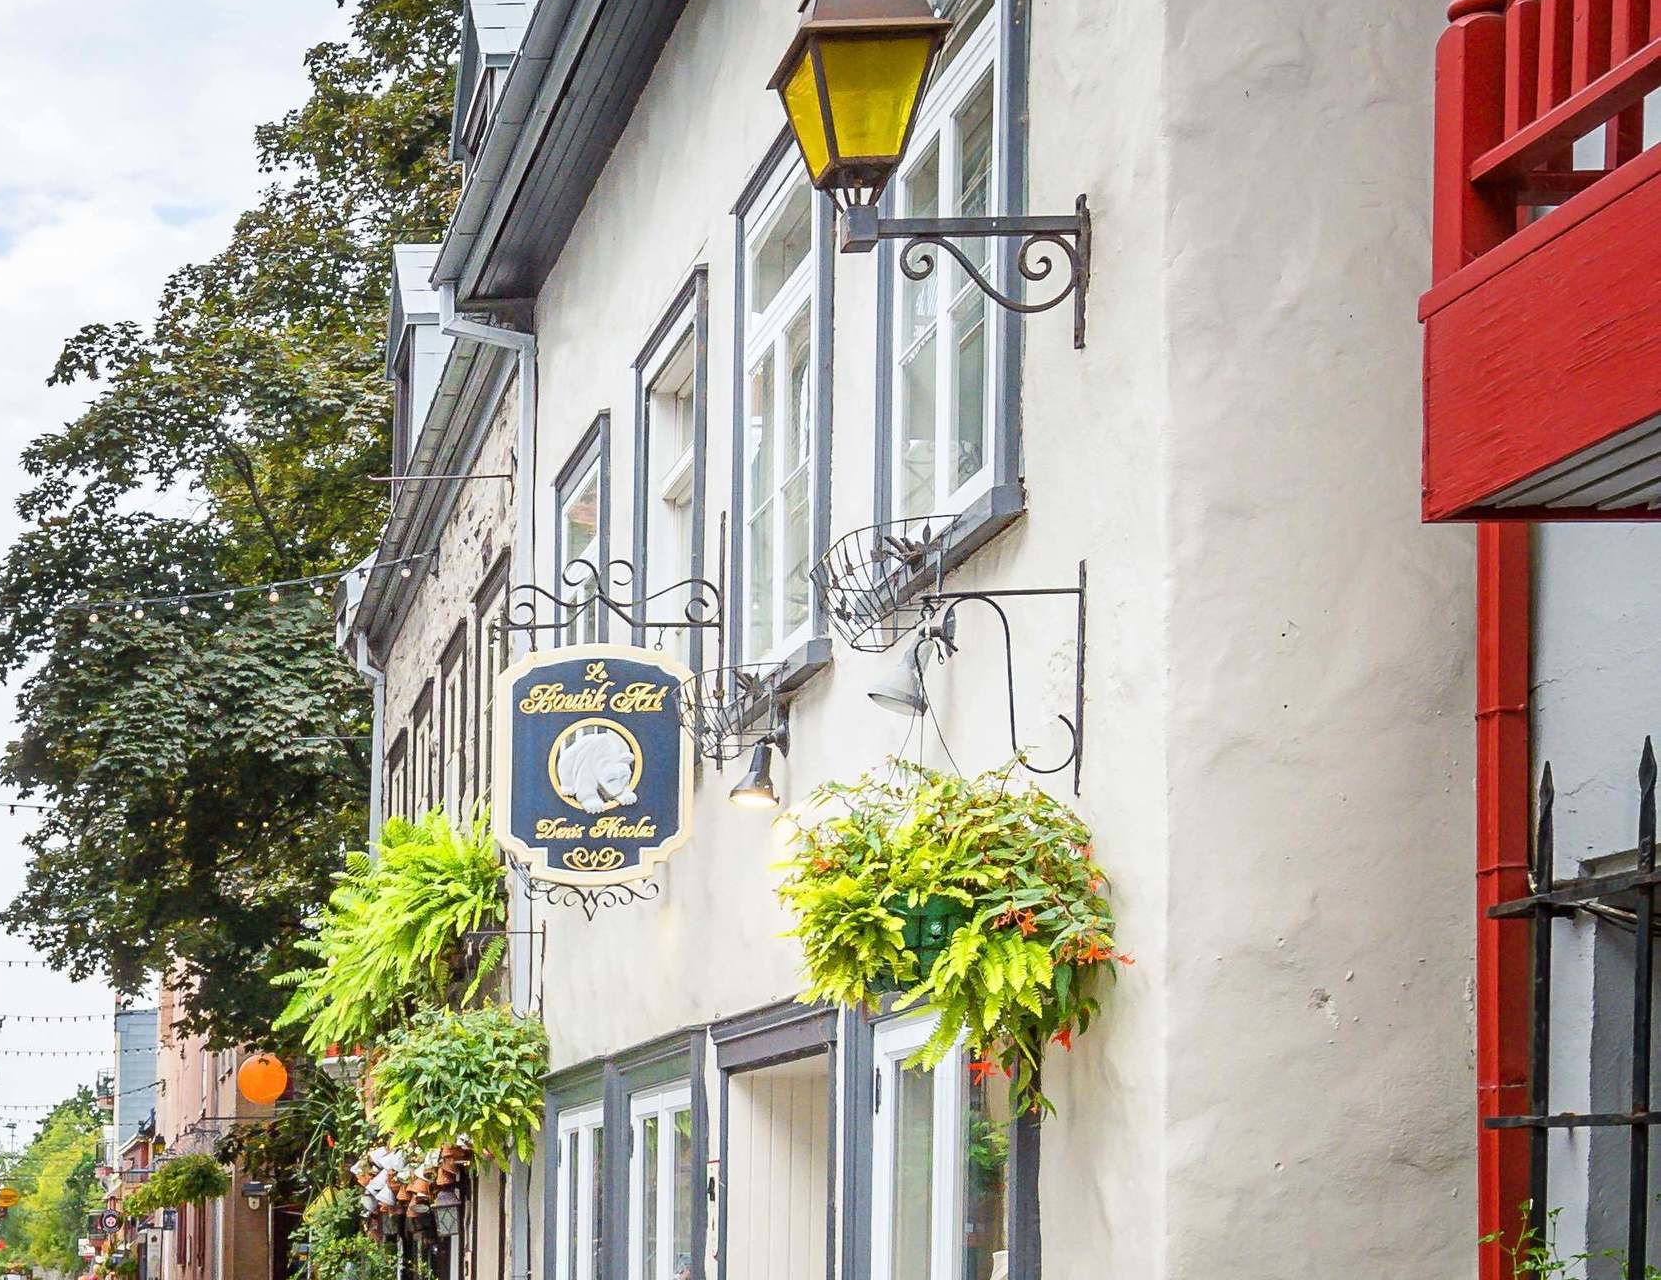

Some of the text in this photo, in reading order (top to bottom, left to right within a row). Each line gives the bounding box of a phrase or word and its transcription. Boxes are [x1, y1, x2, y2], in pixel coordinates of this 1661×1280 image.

[519, 681, 669, 714] Boutik Art
[535, 816, 657, 839] Denis Nicolas
